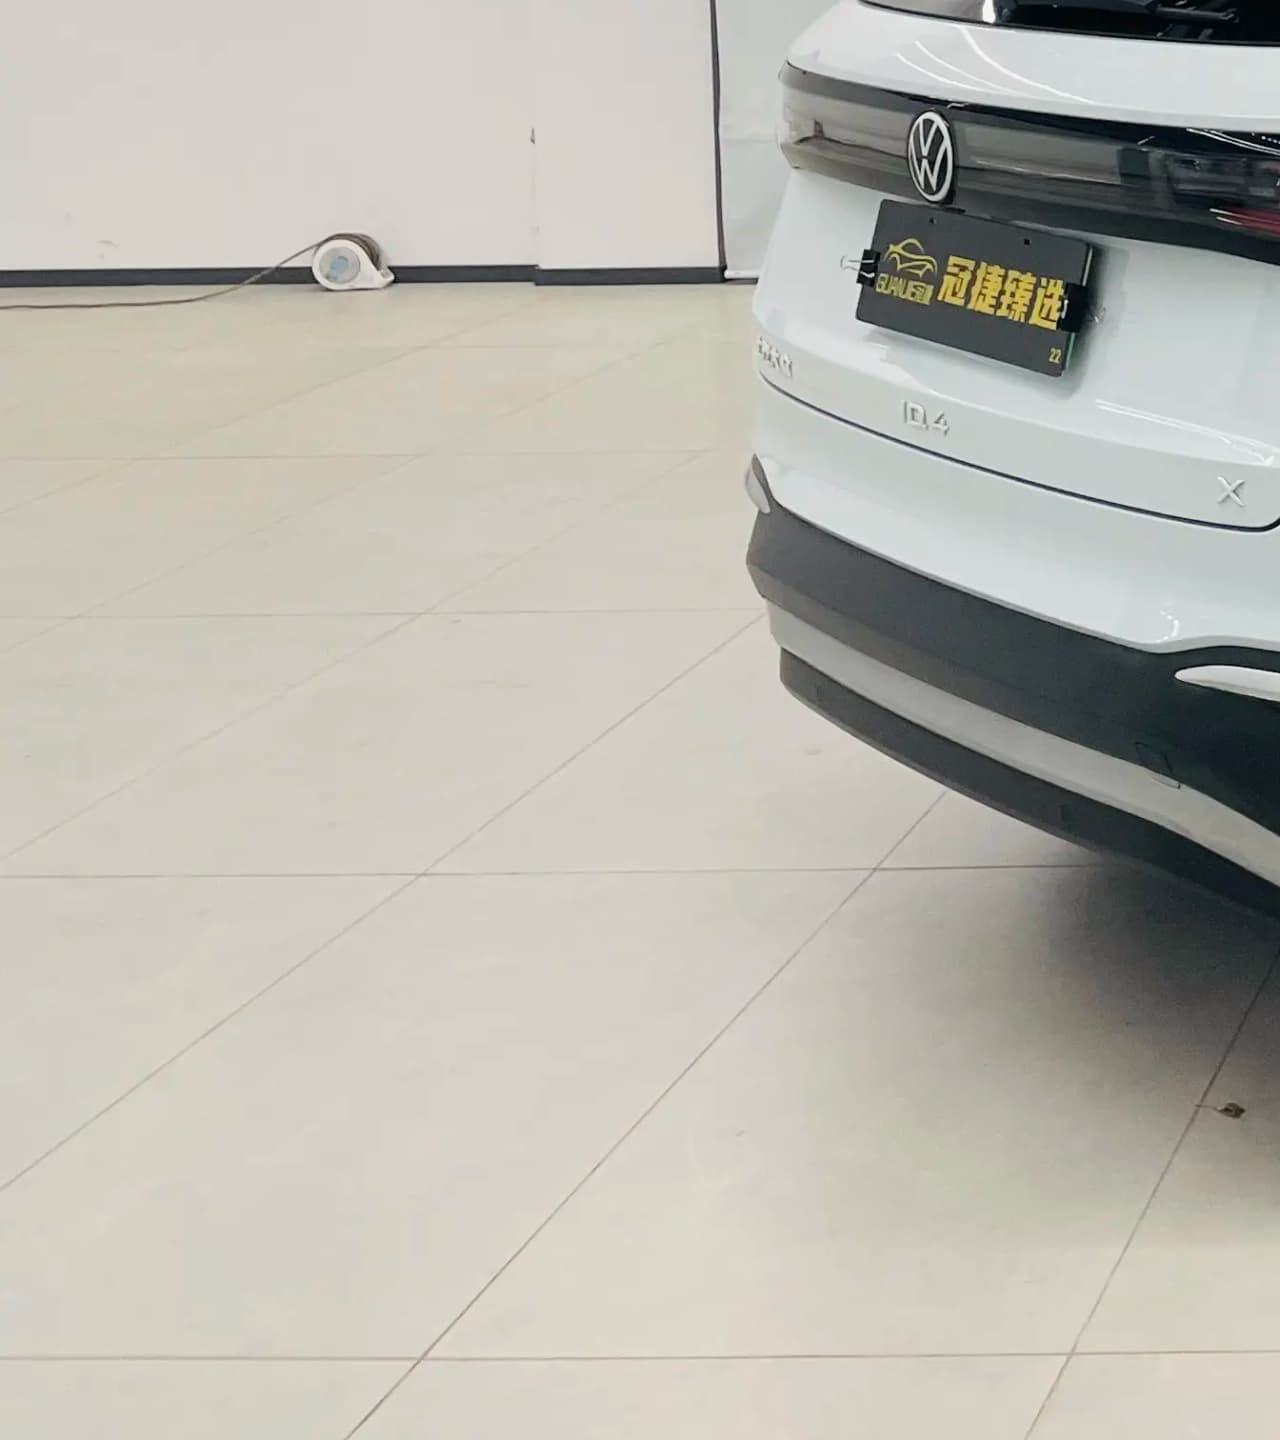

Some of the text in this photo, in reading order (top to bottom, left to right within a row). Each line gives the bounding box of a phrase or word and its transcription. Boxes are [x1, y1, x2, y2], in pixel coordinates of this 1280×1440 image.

[937, 255, 1065, 330] 冠捷臻选
[1216, 476, 1246, 507] X
